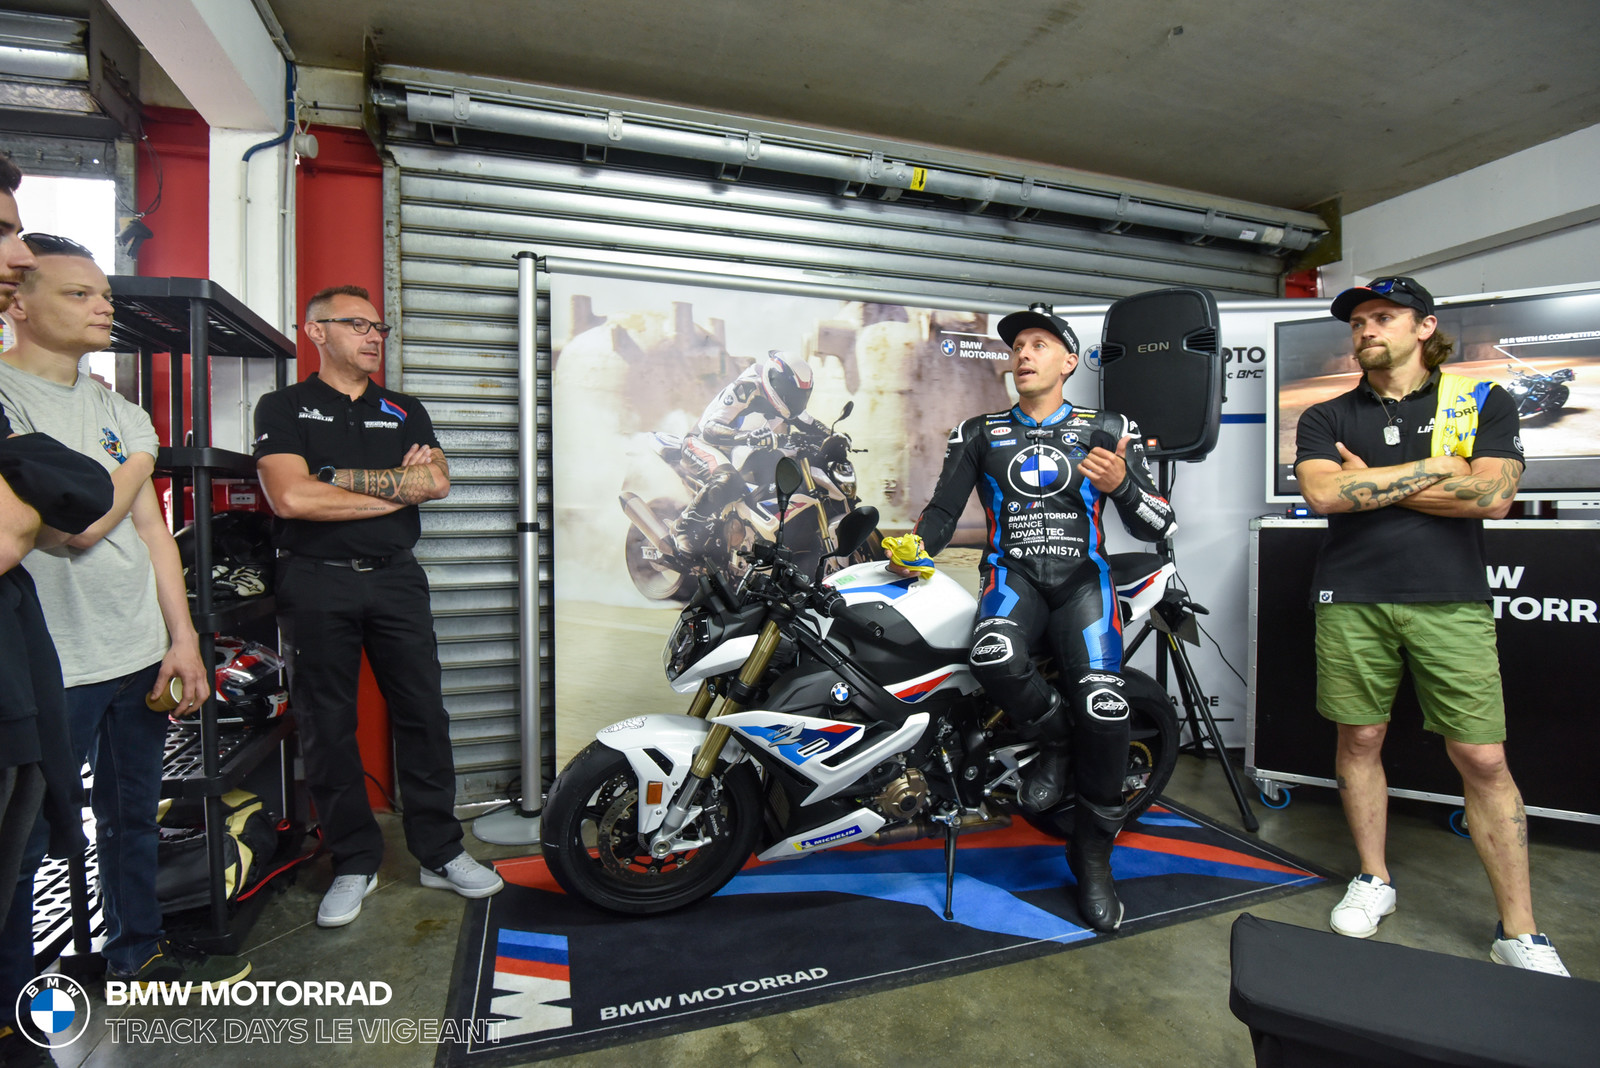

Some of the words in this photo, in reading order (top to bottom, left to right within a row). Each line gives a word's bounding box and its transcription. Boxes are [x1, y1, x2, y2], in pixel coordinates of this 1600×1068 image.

[960, 341, 982, 349] BMW
[1138, 341, 1169, 353] EON
[960, 350, 1009, 360] MOTORRAD
[1237, 370, 1264, 379] BMC
[298, 412, 334, 422] MICHELIN
[1016, 447, 1062, 464] BMW
[1008, 514, 1028, 522] BMW
[1029, 512, 1078, 520] MOTORRAD
[1008, 521, 1043, 529] FRANCE
[1010, 527, 1064, 539] ADVANTEC
[1025, 545, 1080, 557] AVANISTA
[1492, 595, 1600, 623] TORR
[814, 829, 856, 845] MICHELIN
[600, 996, 672, 1021] BMW
[679, 967, 828, 1006] MOTORRAD
